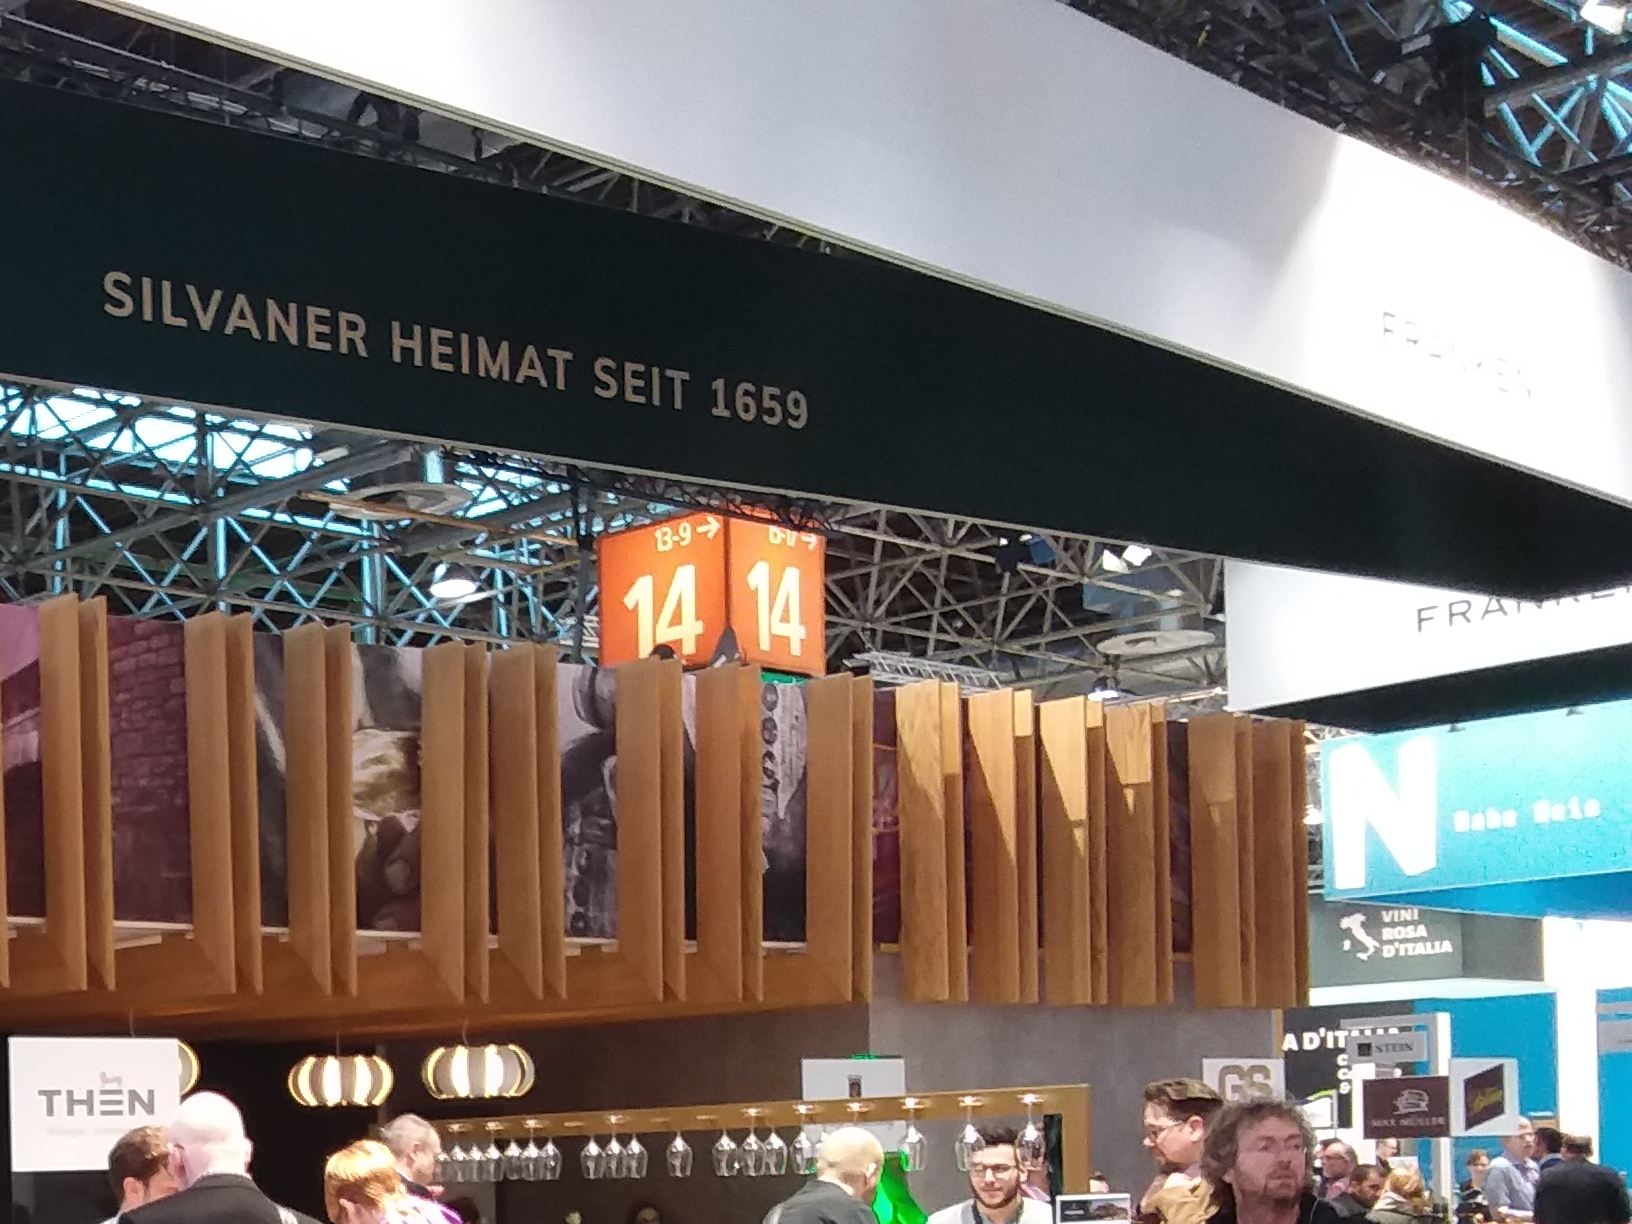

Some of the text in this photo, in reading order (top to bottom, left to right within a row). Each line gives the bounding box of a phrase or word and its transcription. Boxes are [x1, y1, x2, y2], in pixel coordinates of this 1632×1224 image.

[103, 270, 809, 430] SILVANER HEIMAT SEIT 1659
[623, 563, 705, 660] 14
[746, 560, 807, 657] 14
[1329, 735, 1437, 889] N
[1381, 907, 1419, 922] VINI
[1382, 924, 1428, 940] ROSA
[1382, 940, 1453, 958] D'ITALIA
[38, 1089, 155, 1117] THEN
